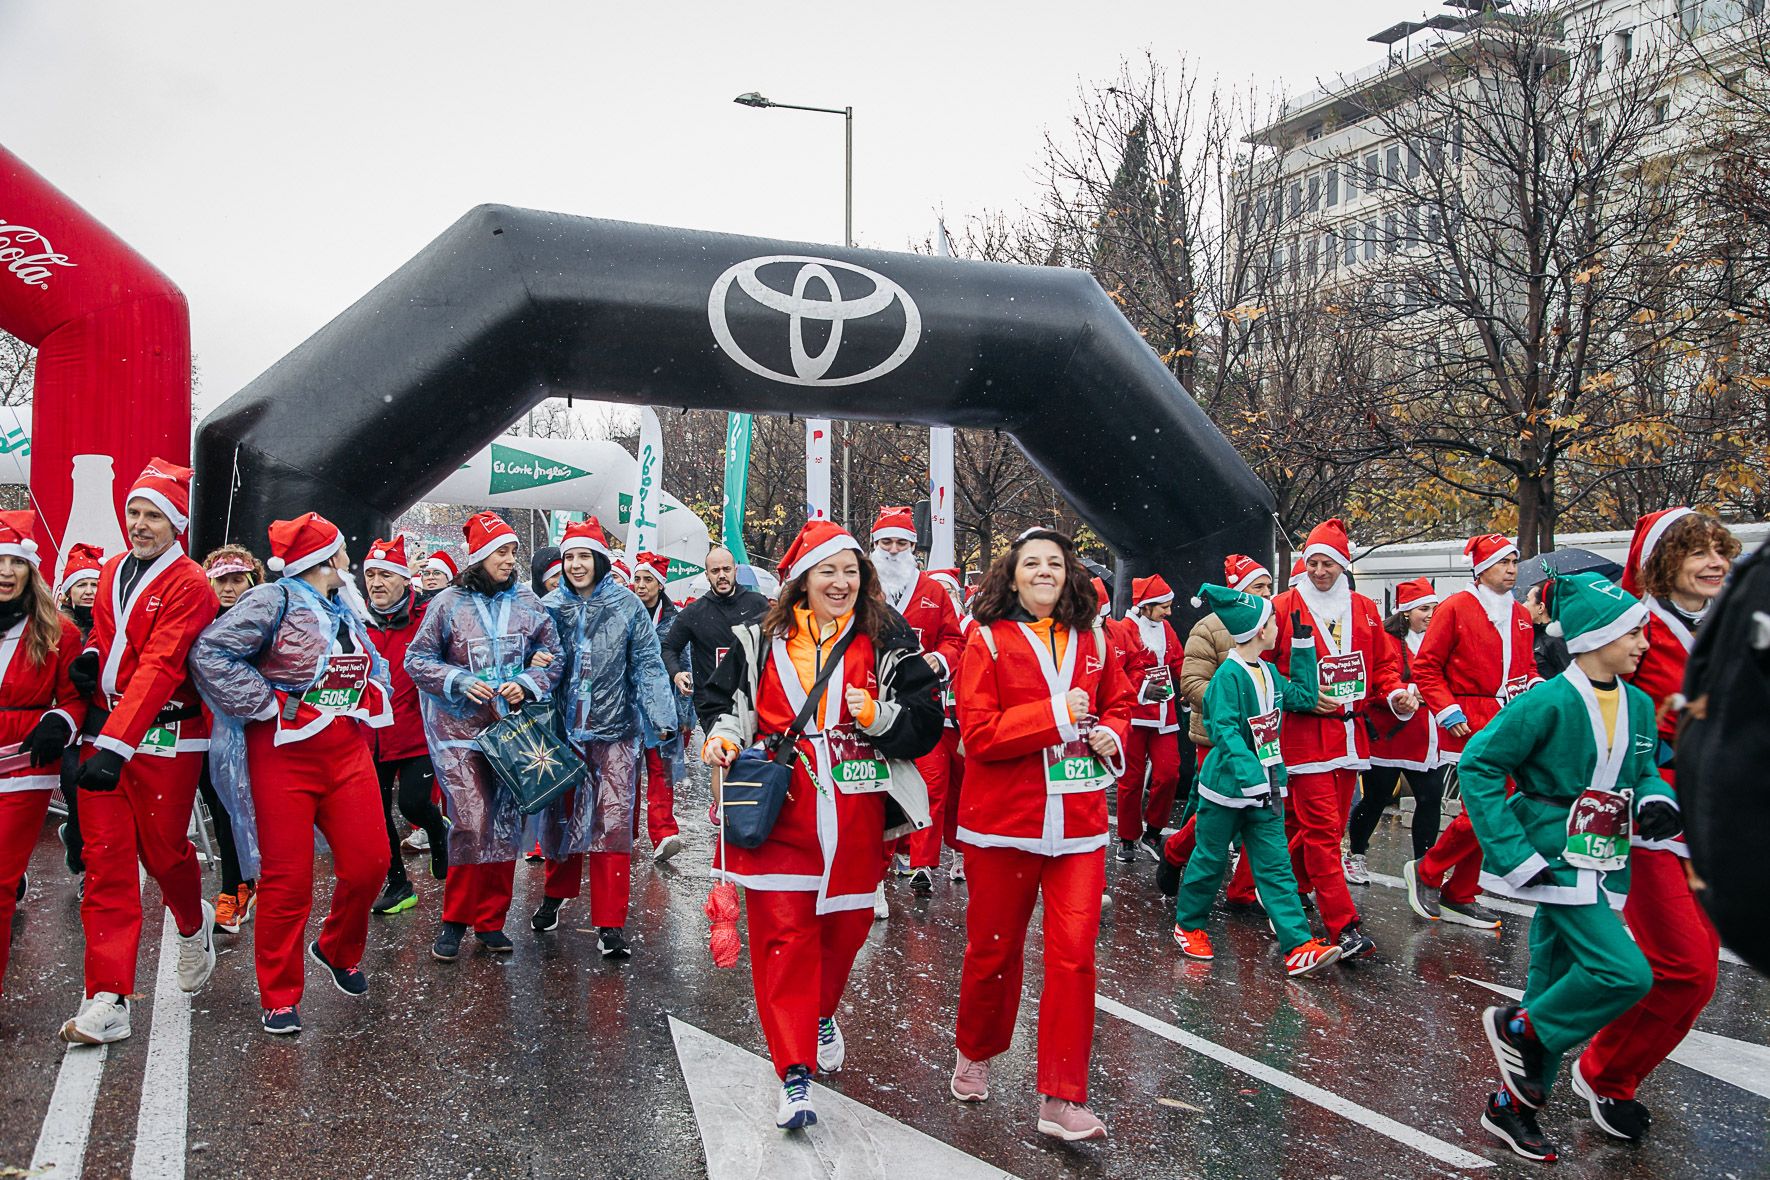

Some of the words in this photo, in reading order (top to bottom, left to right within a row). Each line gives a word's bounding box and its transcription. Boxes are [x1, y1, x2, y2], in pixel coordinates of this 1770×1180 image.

[493, 460, 506, 474] El
[507, 461, 533, 475] Corte
[318, 689, 352, 706] 5064
[842, 760, 877, 781] 6206
